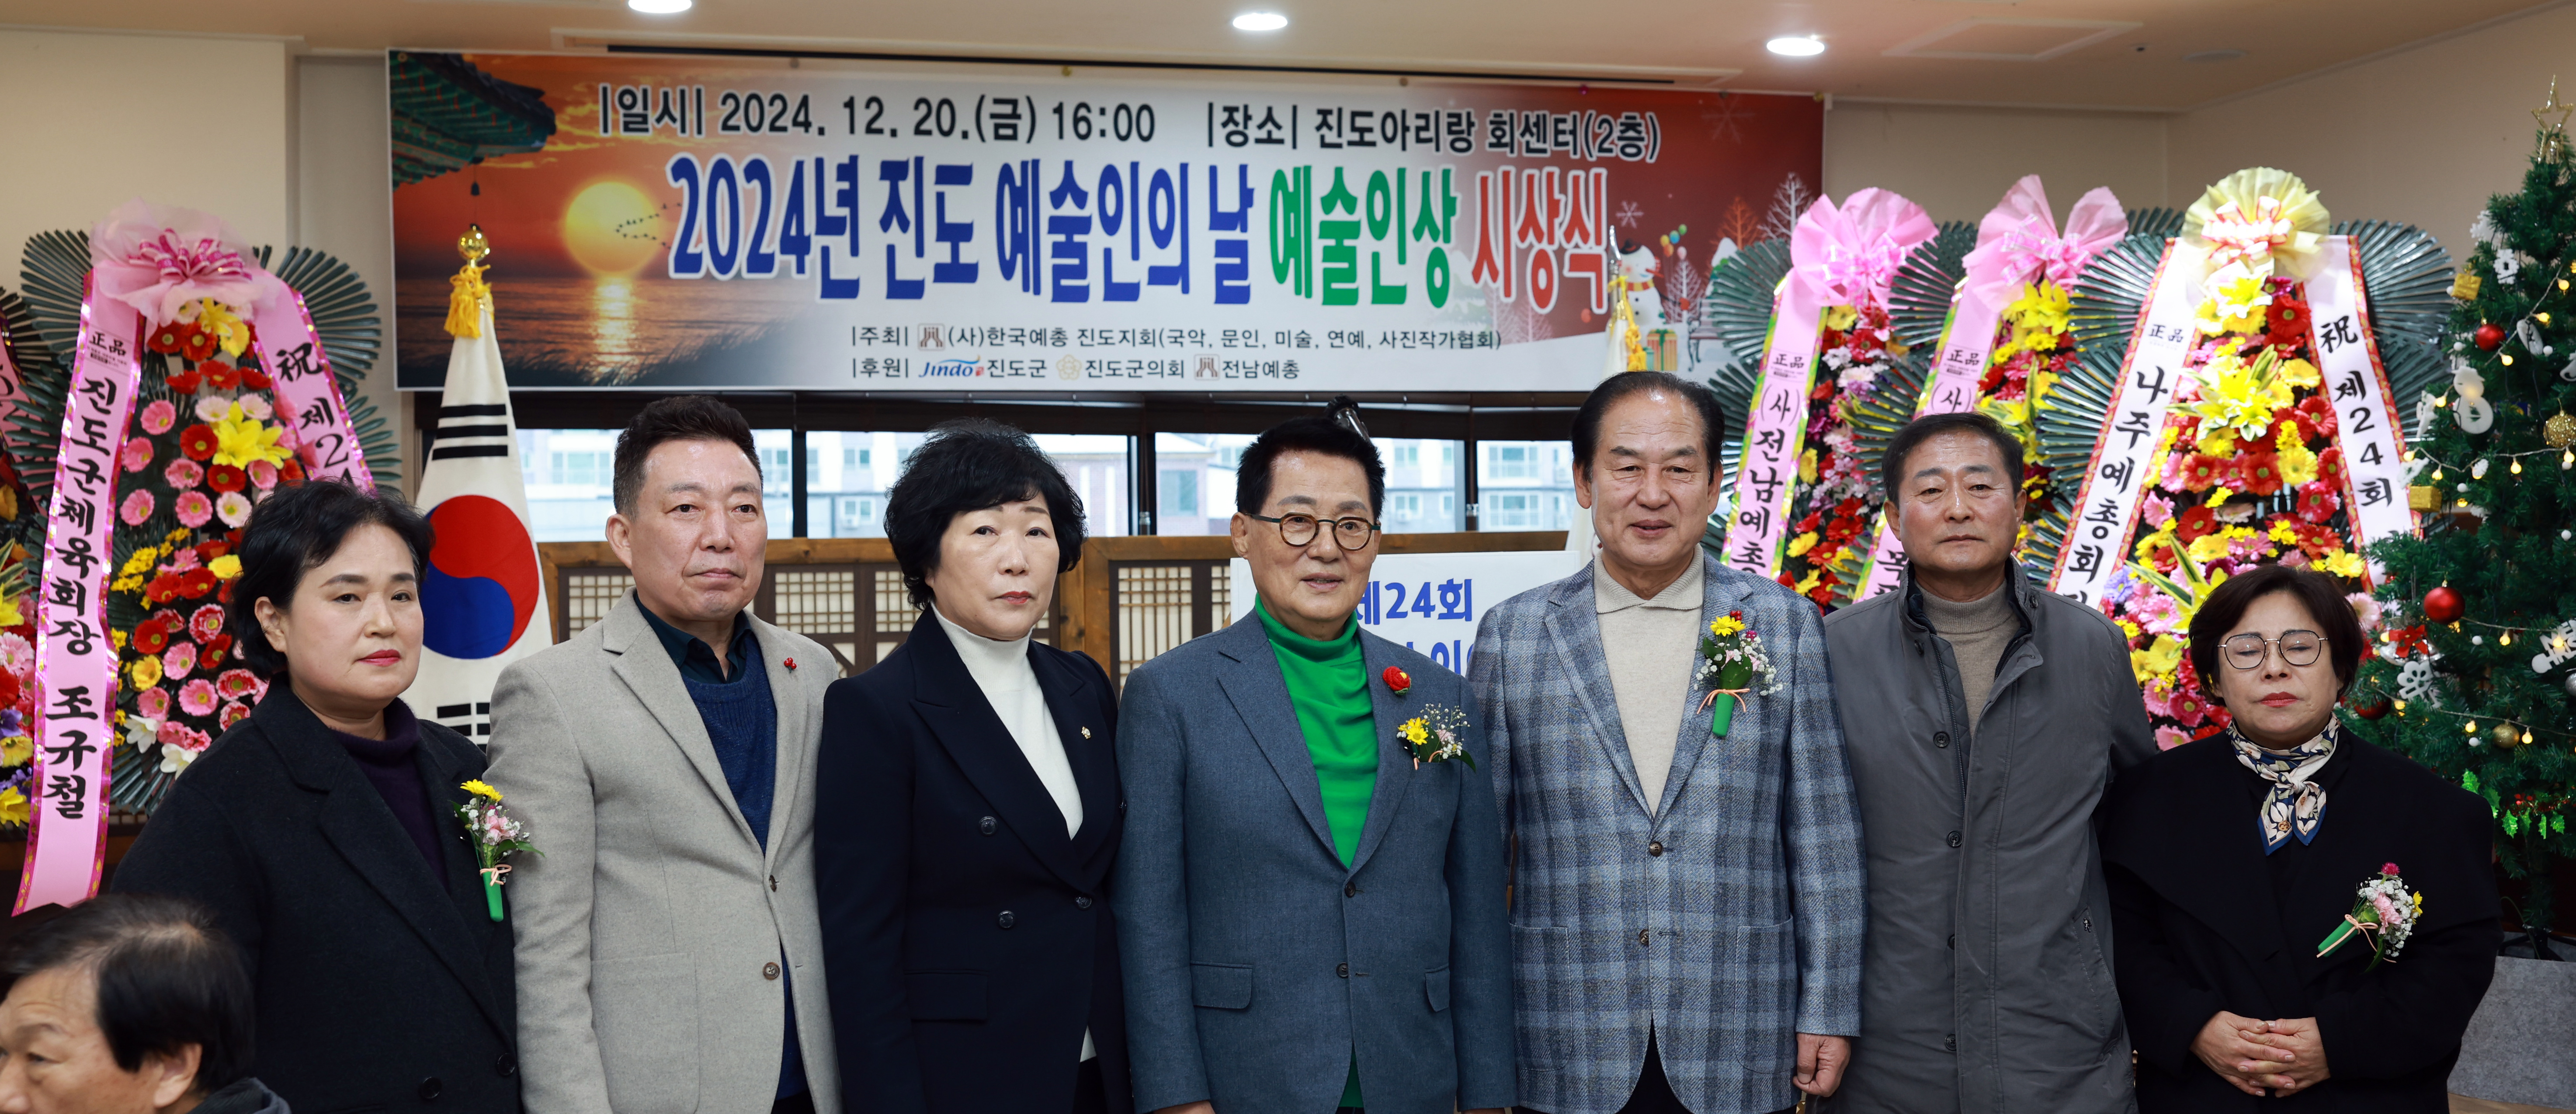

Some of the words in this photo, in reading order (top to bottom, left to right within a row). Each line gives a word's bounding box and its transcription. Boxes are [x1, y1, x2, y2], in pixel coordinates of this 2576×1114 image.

[721, 92, 825, 136] 2024.
[843, 95, 898, 138] 12.
[913, 94, 1036, 143] 20.(금)
[1052, 101, 1155, 142] 16:00
[1315, 108, 1475, 153] 진도아리랑
[1489, 112, 1658, 160] 회센터(2층)
[671, 155, 860, 299] 2024년
[879, 156, 979, 299] 진도
[996, 159, 1190, 302] 예술인의
[1209, 164, 1254, 305] 날
[1270, 165, 1457, 309] 예술인상
[1472, 169, 1606, 310] 시상식
[89, 331, 126, 357] 正品
[948, 327, 1069, 347] (사)한국예총
[1077, 328, 1212, 349] 진도지회(국악,
[1221, 329, 1266, 348] 문인,
[1275, 329, 1318, 348] 미술,
[1328, 329, 1371, 349] 연예,
[1379, 330, 1501, 350] 사진작가협회)
[2149, 324, 2184, 343] 正品
[2320, 315, 2358, 353] 祝
[276, 342, 323, 382] 祝
[919, 361, 974, 377] Jindo
[987, 359, 1047, 378] 진도군
[1085, 359, 1184, 379] 진도군의회
[1222, 361, 1300, 380] 전남예총
[1773, 353, 1804, 368] 正品
[1947, 349, 1979, 366] 正品
[2333, 371, 2393, 507] 제24회
[49, 377, 117, 655] 진도군체육회장
[43, 685, 98, 819] 조규철
